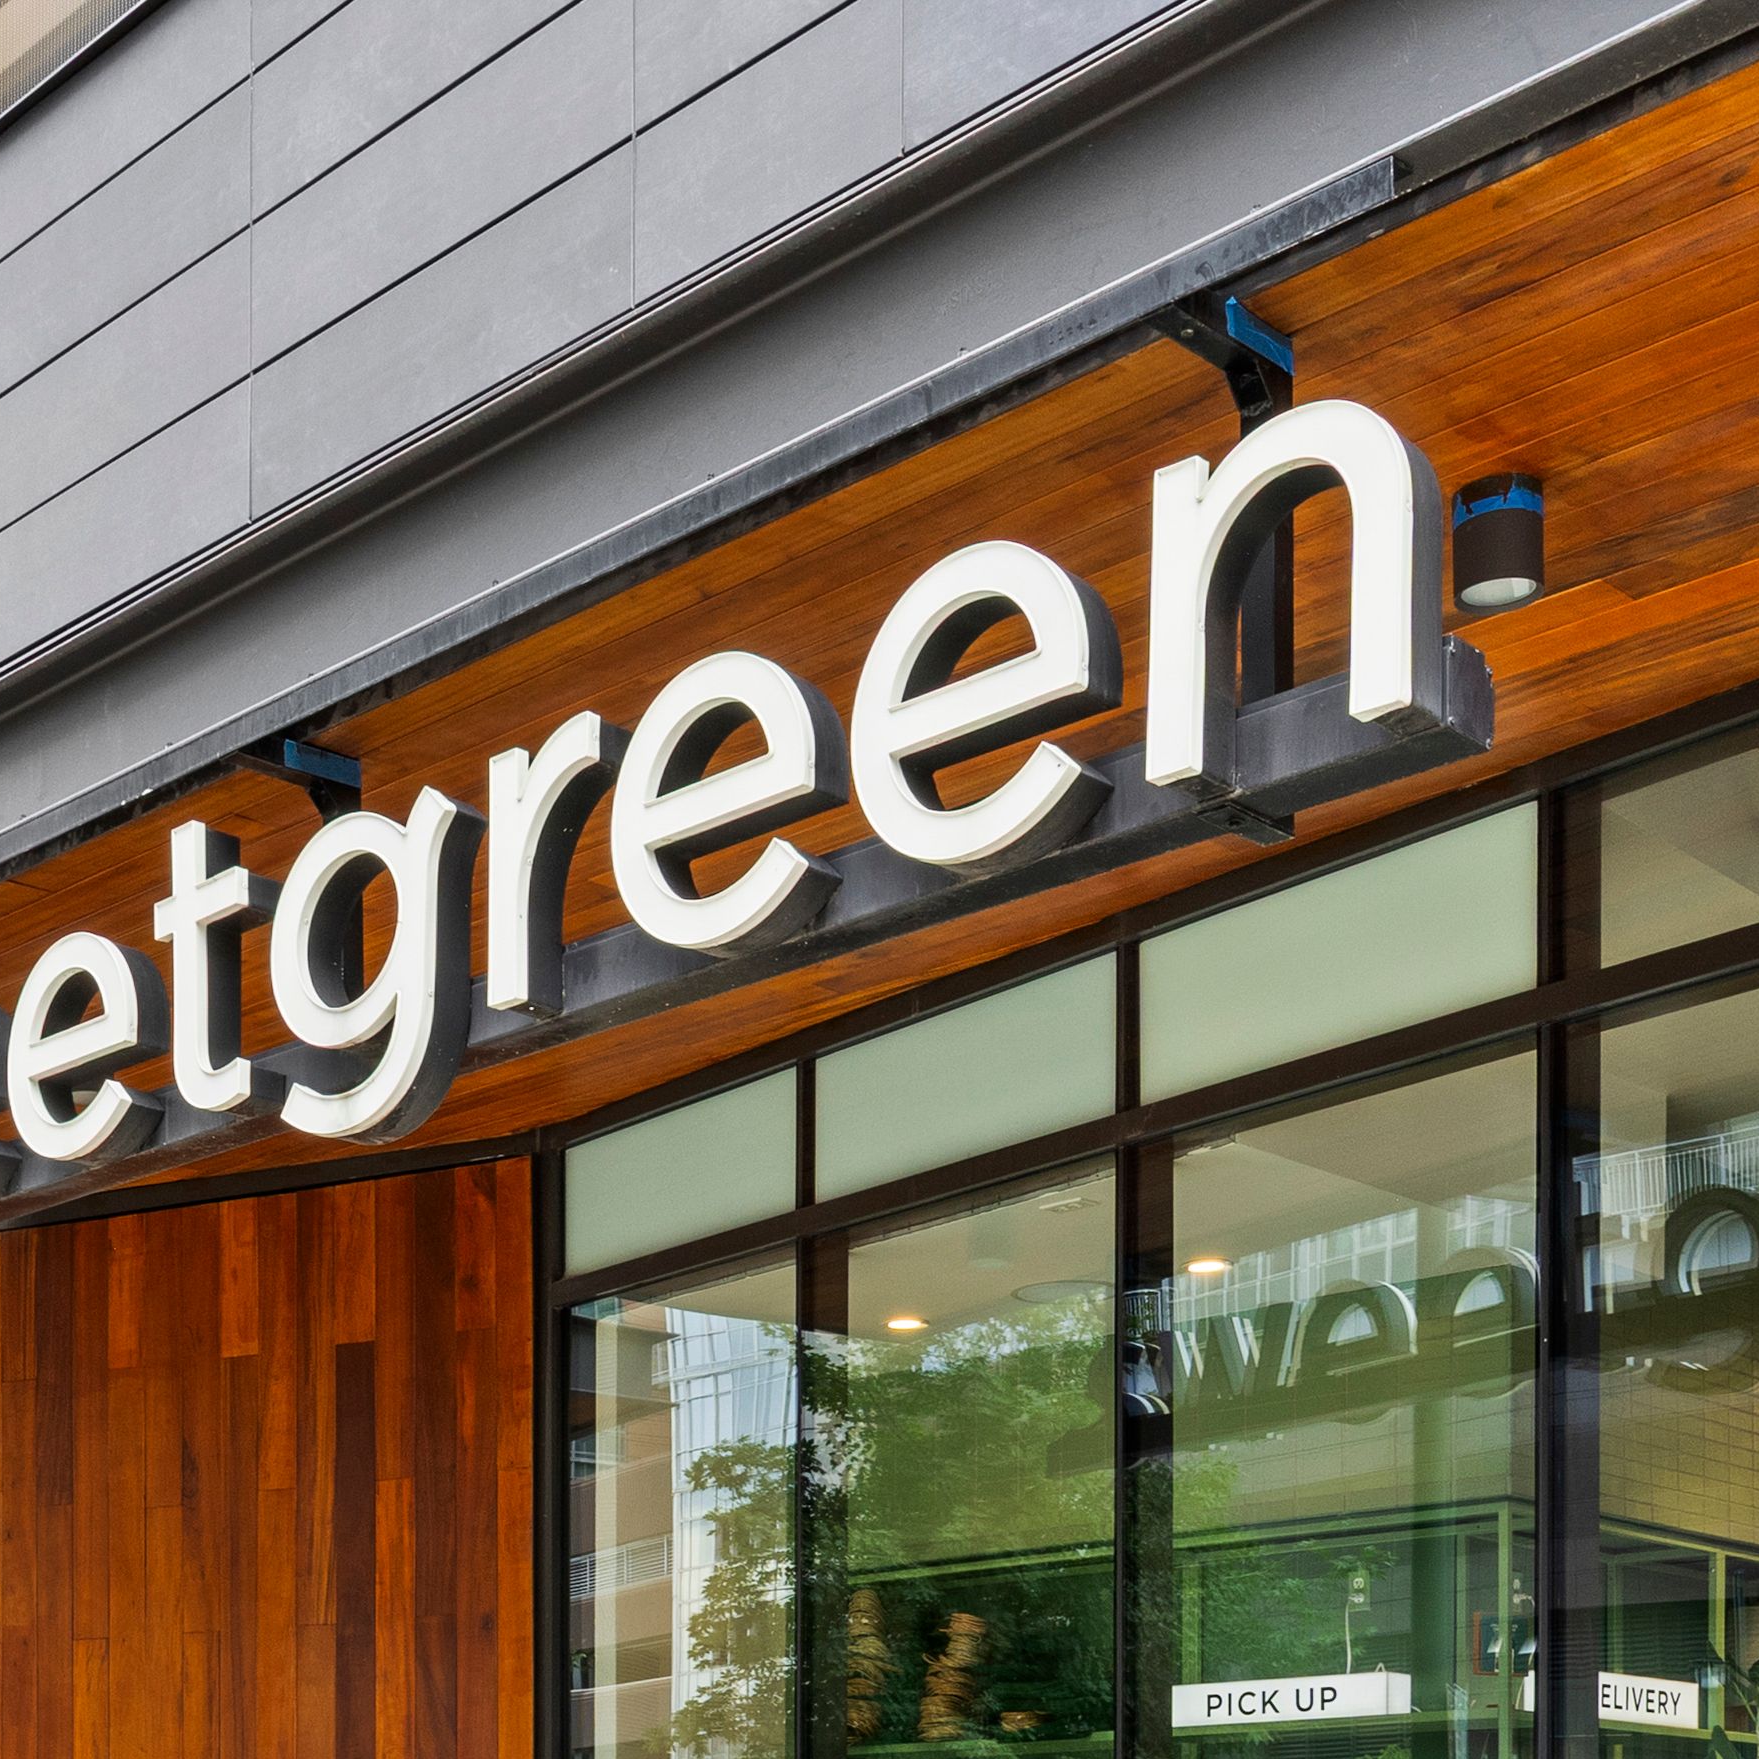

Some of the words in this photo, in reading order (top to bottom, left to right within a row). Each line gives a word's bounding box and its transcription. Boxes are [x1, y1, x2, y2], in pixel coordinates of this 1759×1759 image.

[1207, 1689, 1280, 1717] PICK
[1295, 1686, 1337, 1712] UP
[1601, 1683, 1682, 1717] ELIVERY
